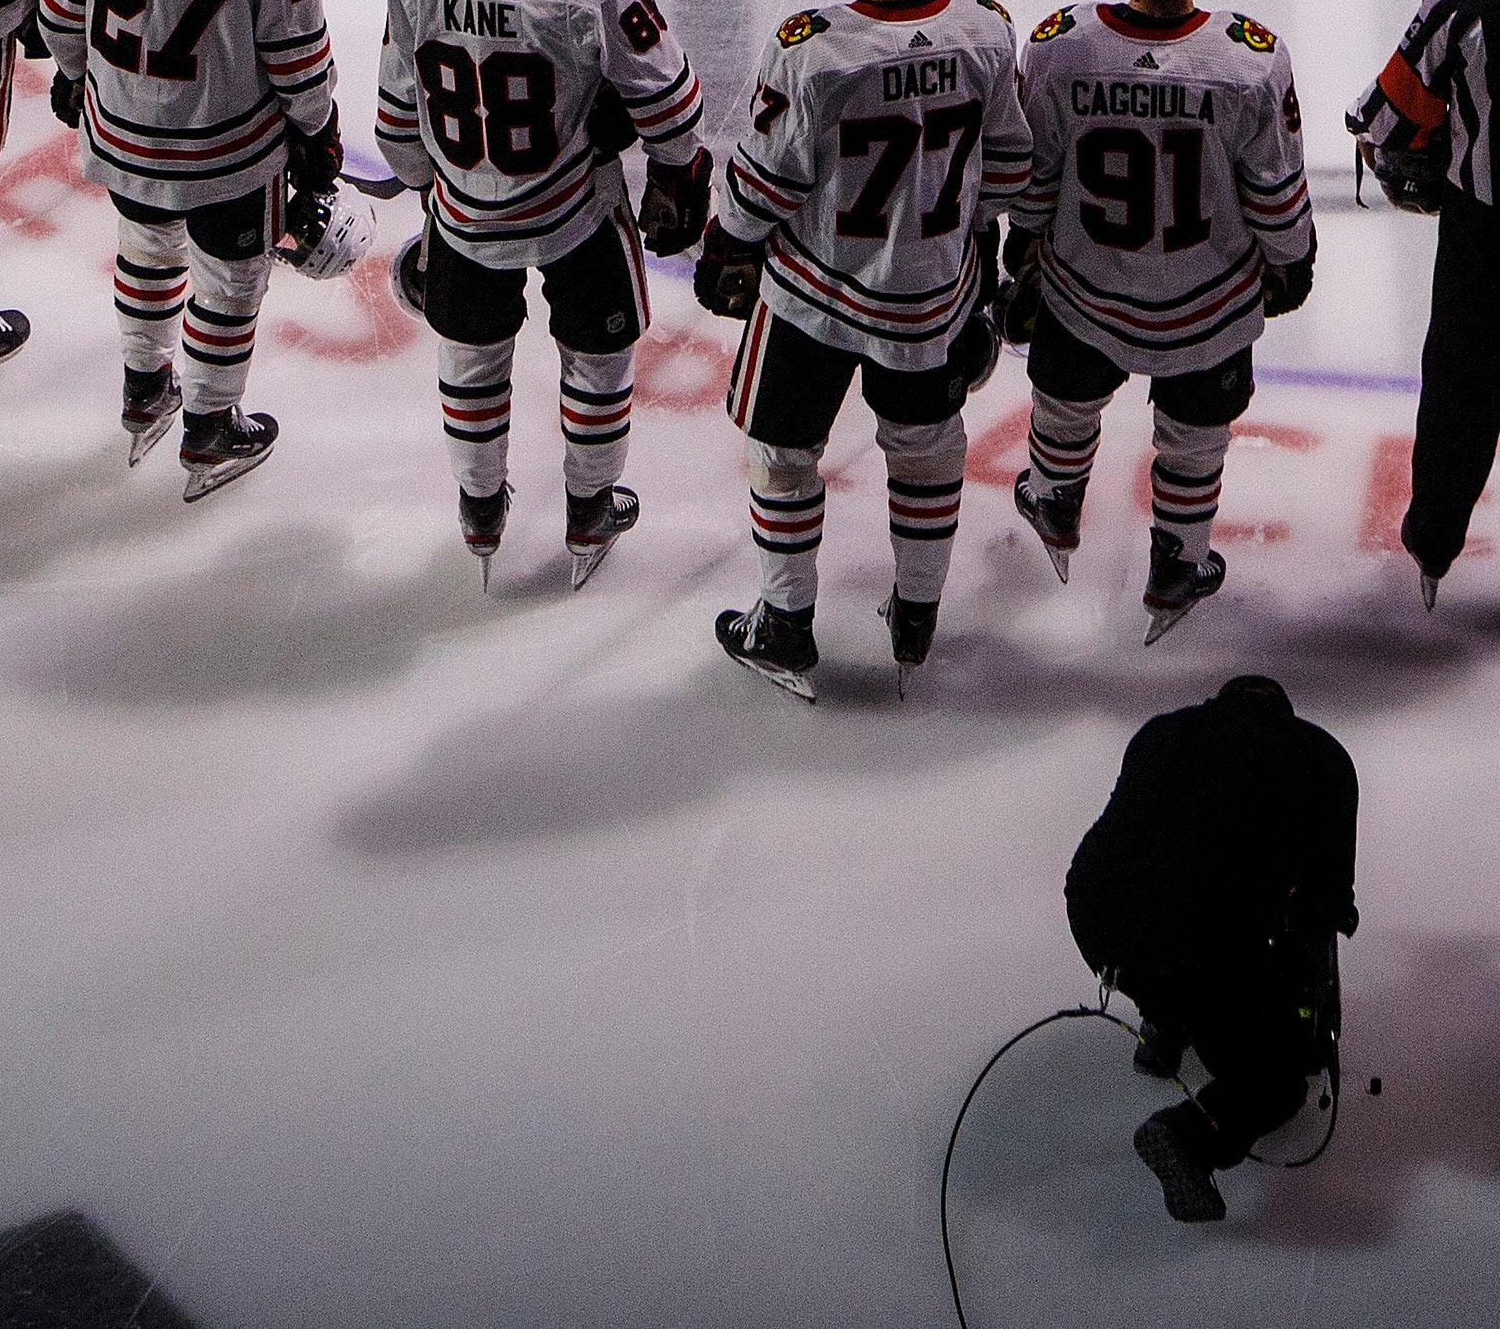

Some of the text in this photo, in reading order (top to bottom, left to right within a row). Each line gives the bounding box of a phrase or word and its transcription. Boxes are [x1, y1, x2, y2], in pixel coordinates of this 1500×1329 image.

[413, 39, 563, 178] 88
[751, 69, 791, 136] 7
[881, 56, 958, 104] DACH
[1069, 79, 1216, 126] CAGGIULA
[835, 96, 984, 241] 77
[1076, 125, 1212, 255] 91
